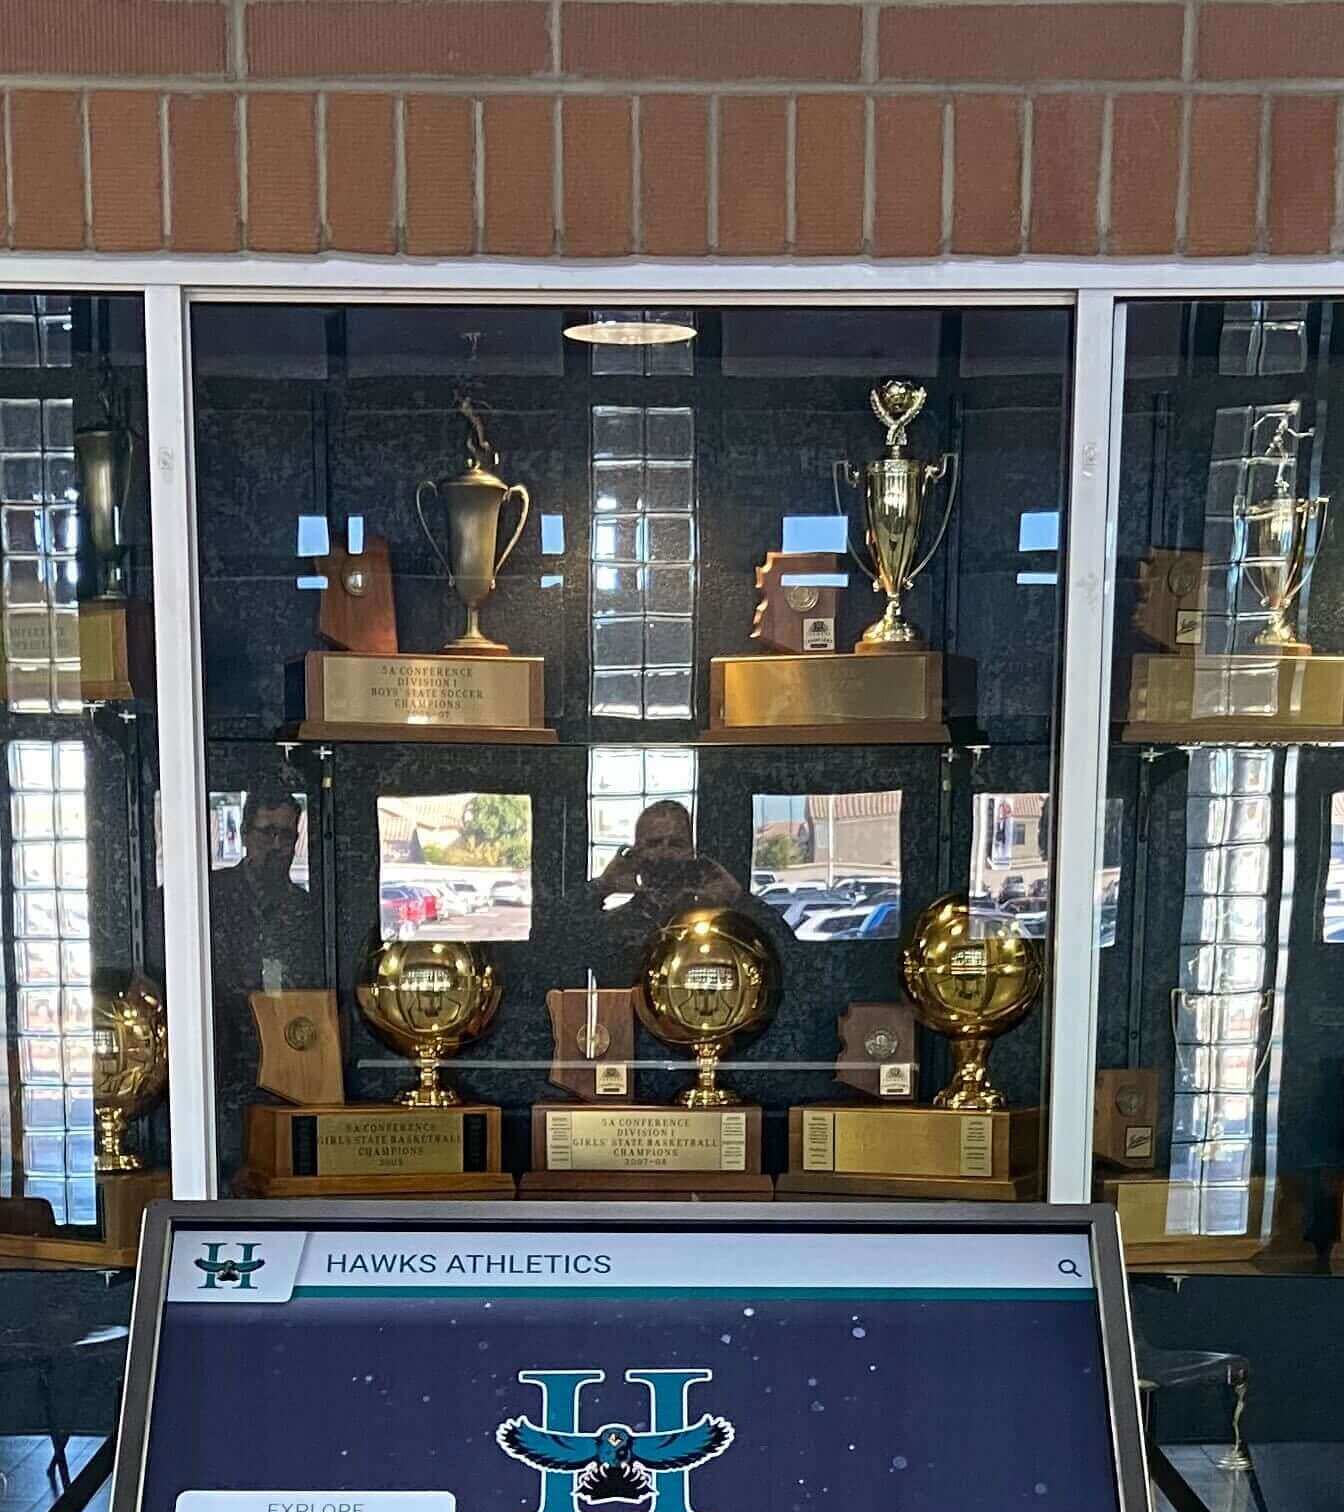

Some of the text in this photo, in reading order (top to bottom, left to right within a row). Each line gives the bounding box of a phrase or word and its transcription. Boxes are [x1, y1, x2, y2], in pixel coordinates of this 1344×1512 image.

[399, 665, 473, 678] CONFERENCE
[397, 677, 449, 688] DIVISION
[406, 688, 436, 699] STATE
[440, 689, 483, 700] SOCCER
[394, 699, 462, 709] CHAMPIONS
[362, 1120, 436, 1133] CONFERENCE
[618, 1117, 690, 1128] CONFERENCE
[616, 1127, 669, 1138] DIVISION
[391, 1134, 461, 1146] BASKETBALL
[611, 1137, 643, 1148] STATE
[646, 1138, 719, 1148] BASKETBALL
[358, 1146, 425, 1157] CHAMPIONS
[612, 1148, 680, 1158] CHAMPIONS
[326, 1253, 613, 1275] HAWKS ATHLETICS
